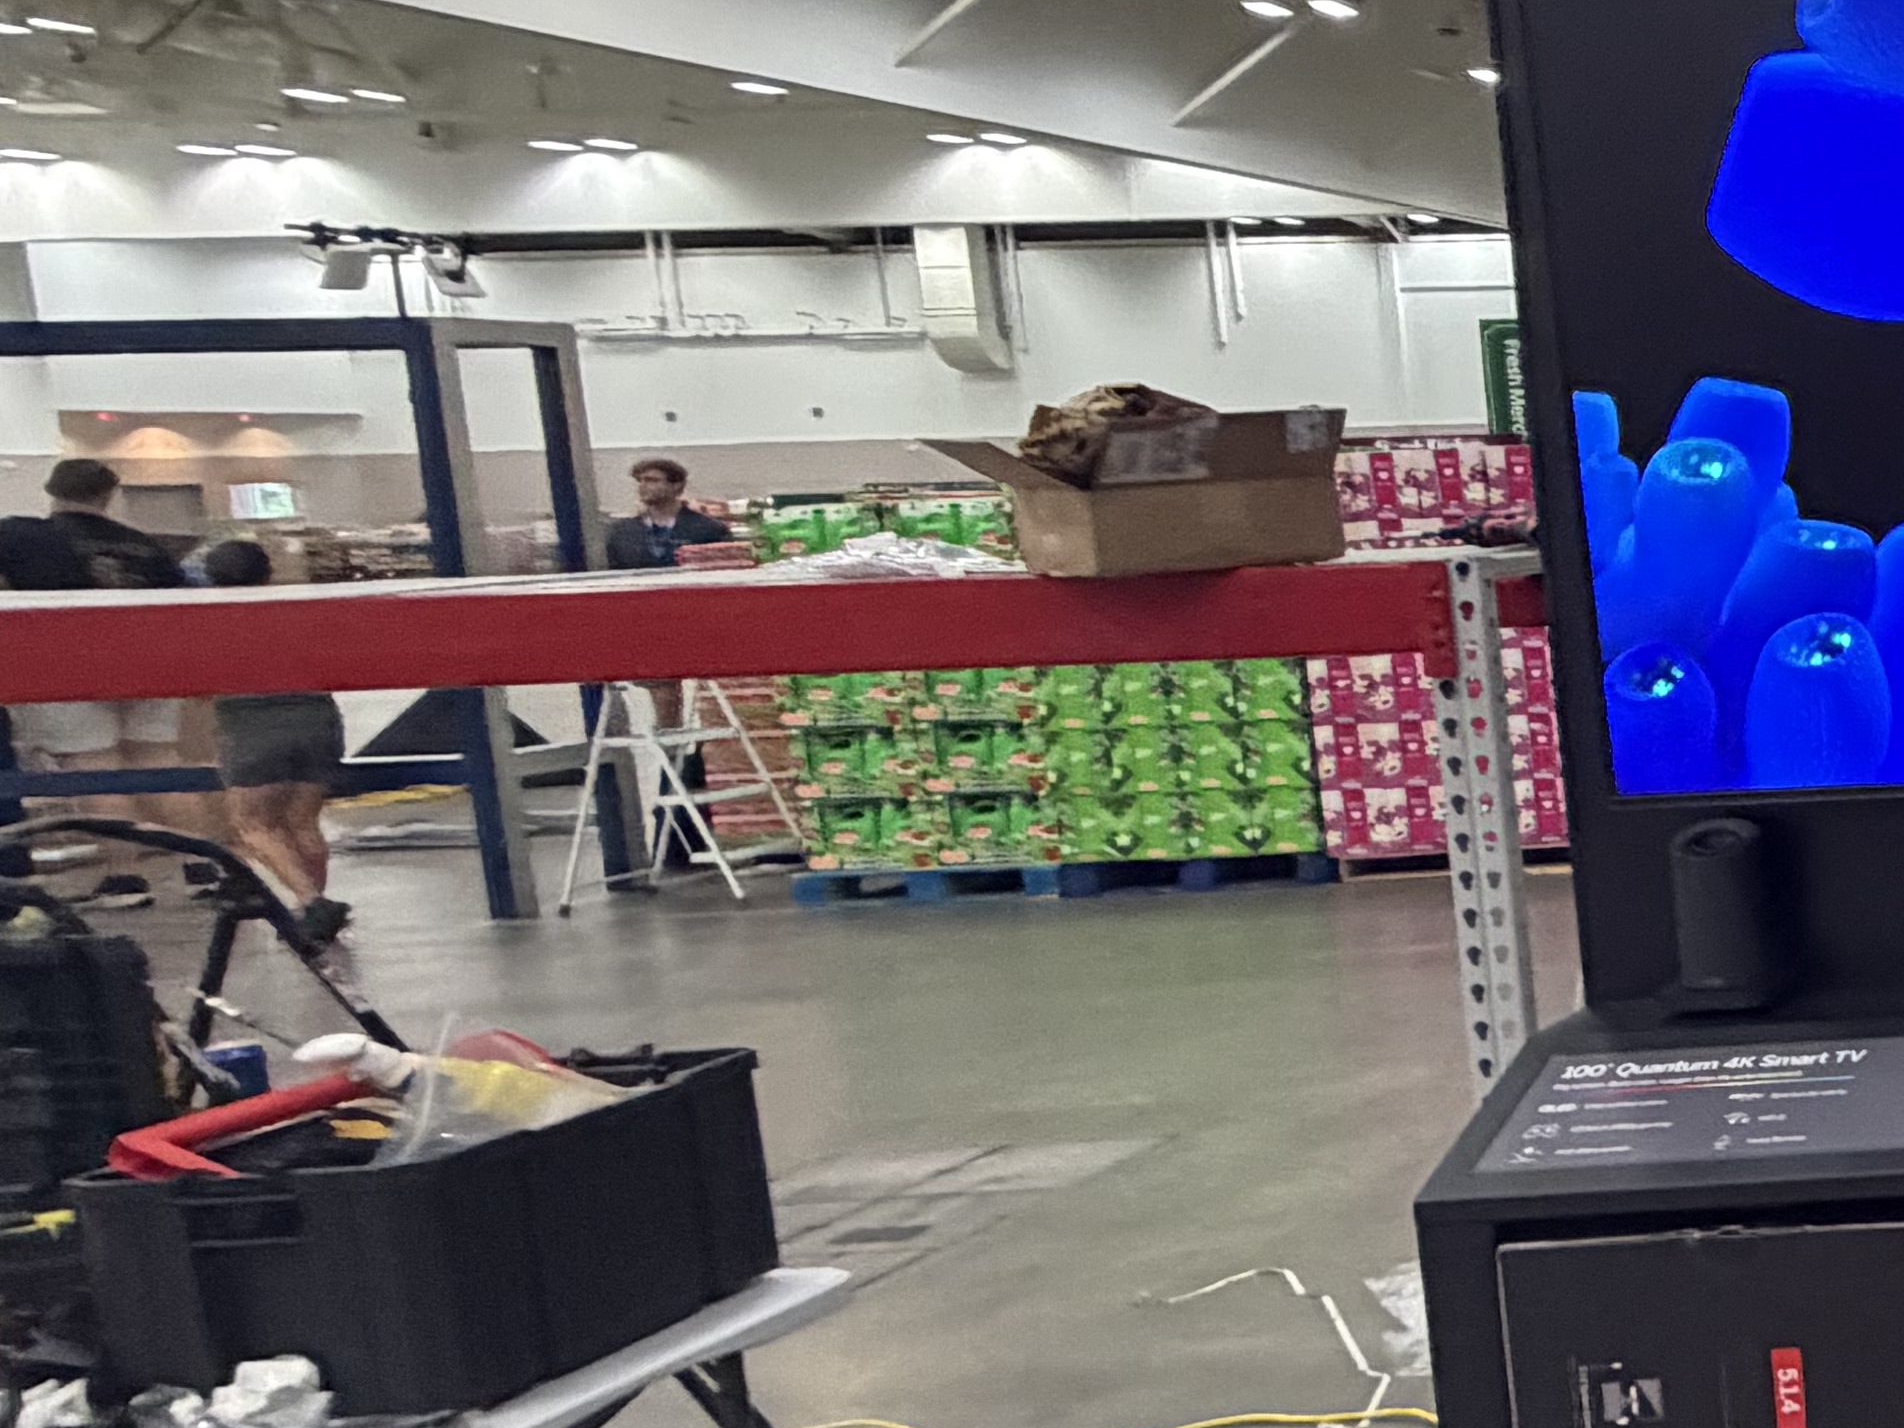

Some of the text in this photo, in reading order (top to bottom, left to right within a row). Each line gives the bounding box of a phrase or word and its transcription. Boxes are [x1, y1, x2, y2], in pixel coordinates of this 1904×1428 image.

[1616, 1060, 1719, 1079] Quantum
[1723, 1056, 1756, 1069] 4K
[1759, 1051, 1830, 1068] Smart
[1835, 1049, 1868, 1063] TV
